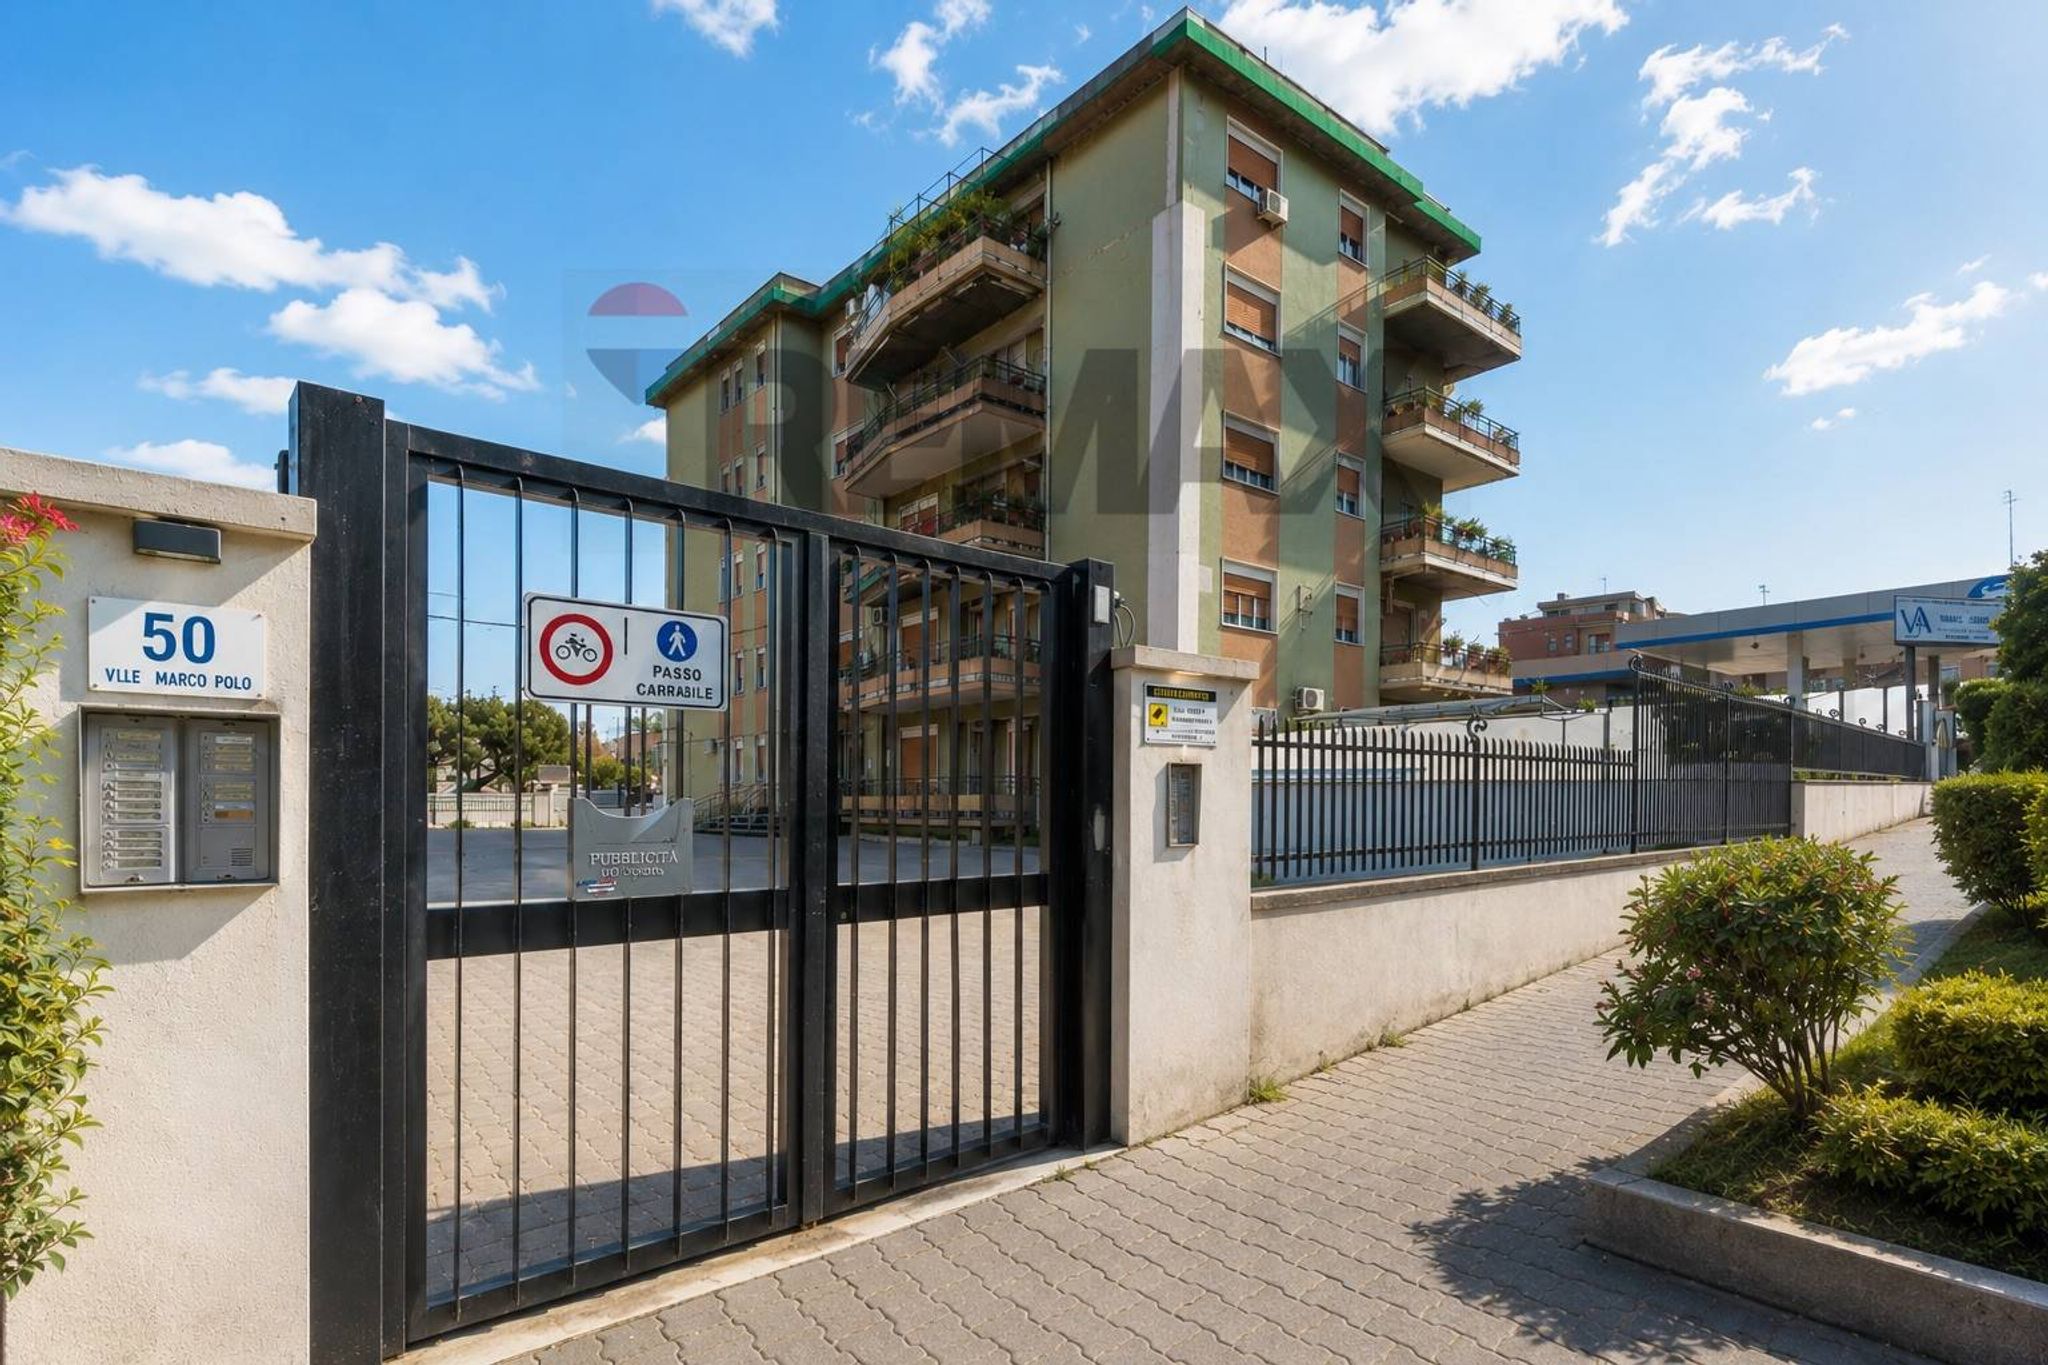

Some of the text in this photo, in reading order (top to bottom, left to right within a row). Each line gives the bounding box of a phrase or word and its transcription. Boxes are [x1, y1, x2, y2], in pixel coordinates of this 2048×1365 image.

[142, 611, 216, 665] 50
[155, 670, 207, 688] MARCO
[214, 674, 252, 691] POLO
[652, 665, 701, 681] PASSO
[636, 682, 714, 700] CARRABILE
